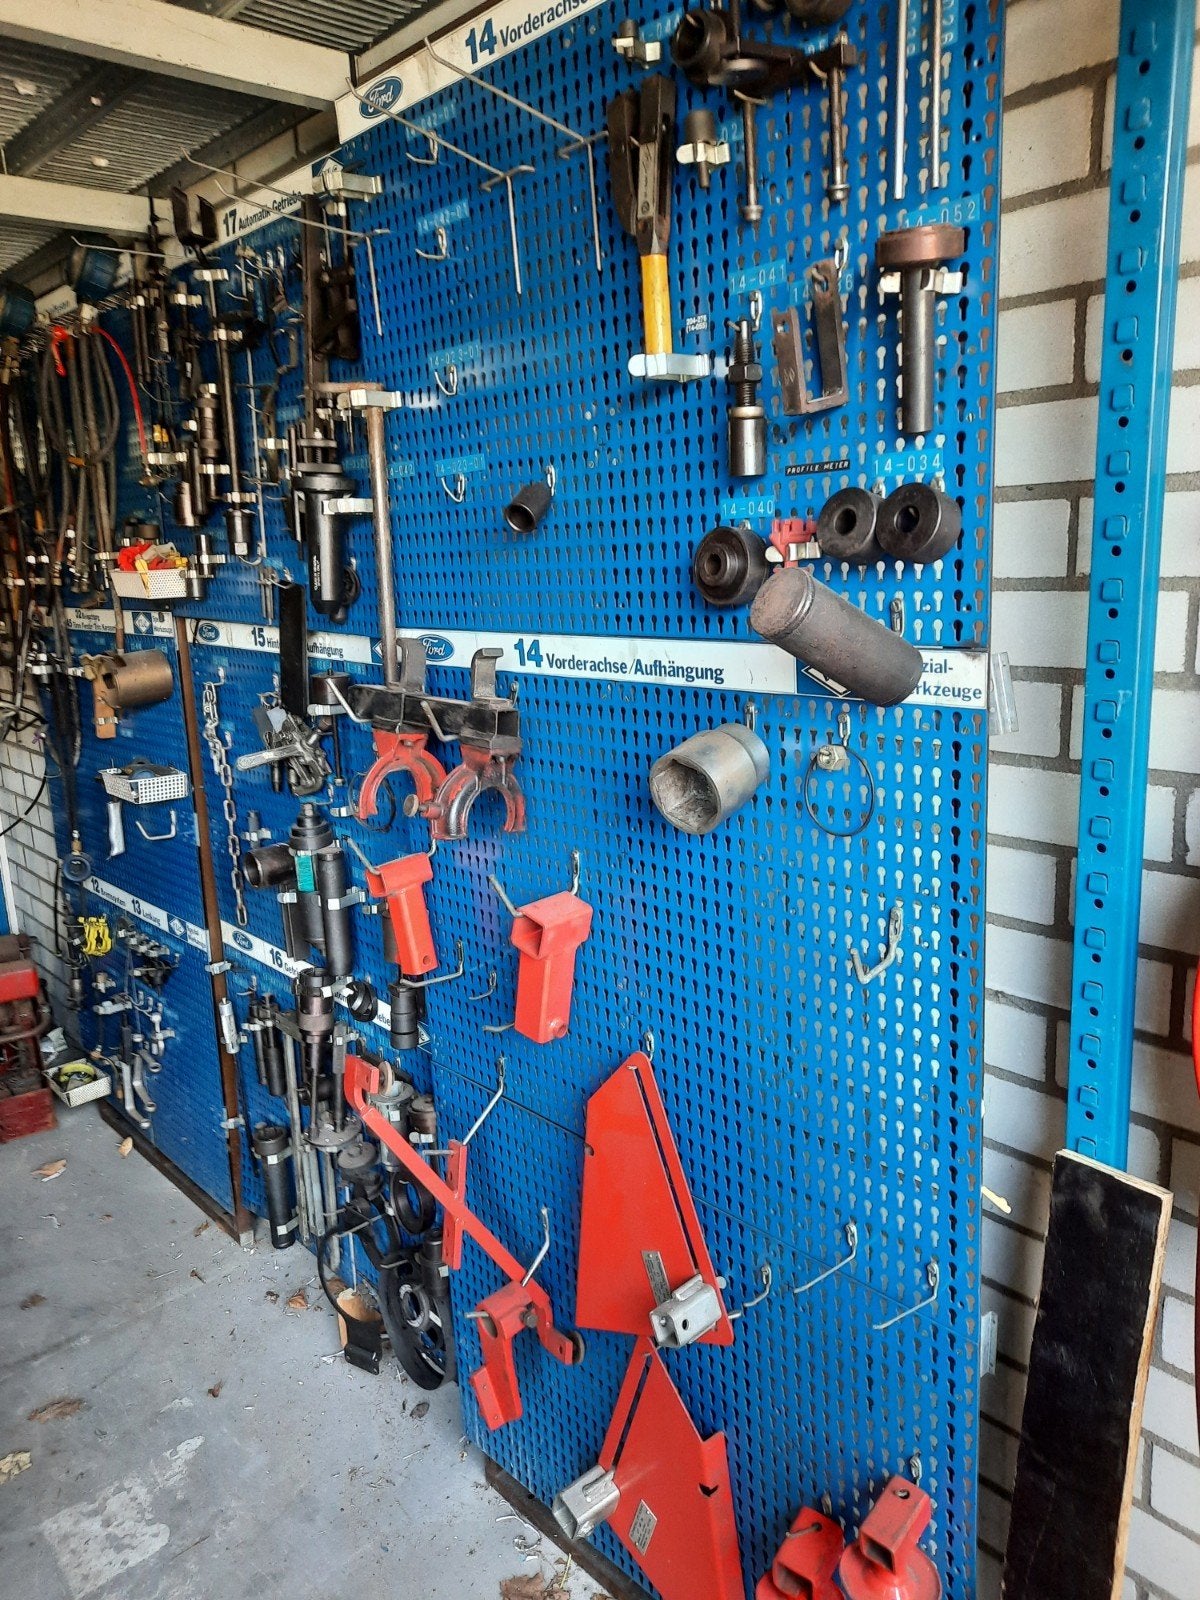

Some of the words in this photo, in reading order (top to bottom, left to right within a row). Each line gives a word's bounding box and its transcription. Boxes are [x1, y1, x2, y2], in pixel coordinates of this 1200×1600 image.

[465, 18, 497, 64] 14
[500, 0, 588, 47] Vorderachs
[223, 208, 237, 237] 17
[732, 264, 785, 292] 14-041
[786, 464, 819, 474] PROFILE
[823, 461, 849, 470] METER
[874, 453, 940, 475] 14-034
[723, 500, 773, 516] 14-040
[251, 627, 265, 647] 15
[514, 638, 543, 668] 14
[921, 658, 953, 674] zial-
[914, 680, 982, 702] rkzeuge
[91, 877, 100, 894] 12
[132, 897, 142, 915] 13
[270, 948, 283, 969] 16
